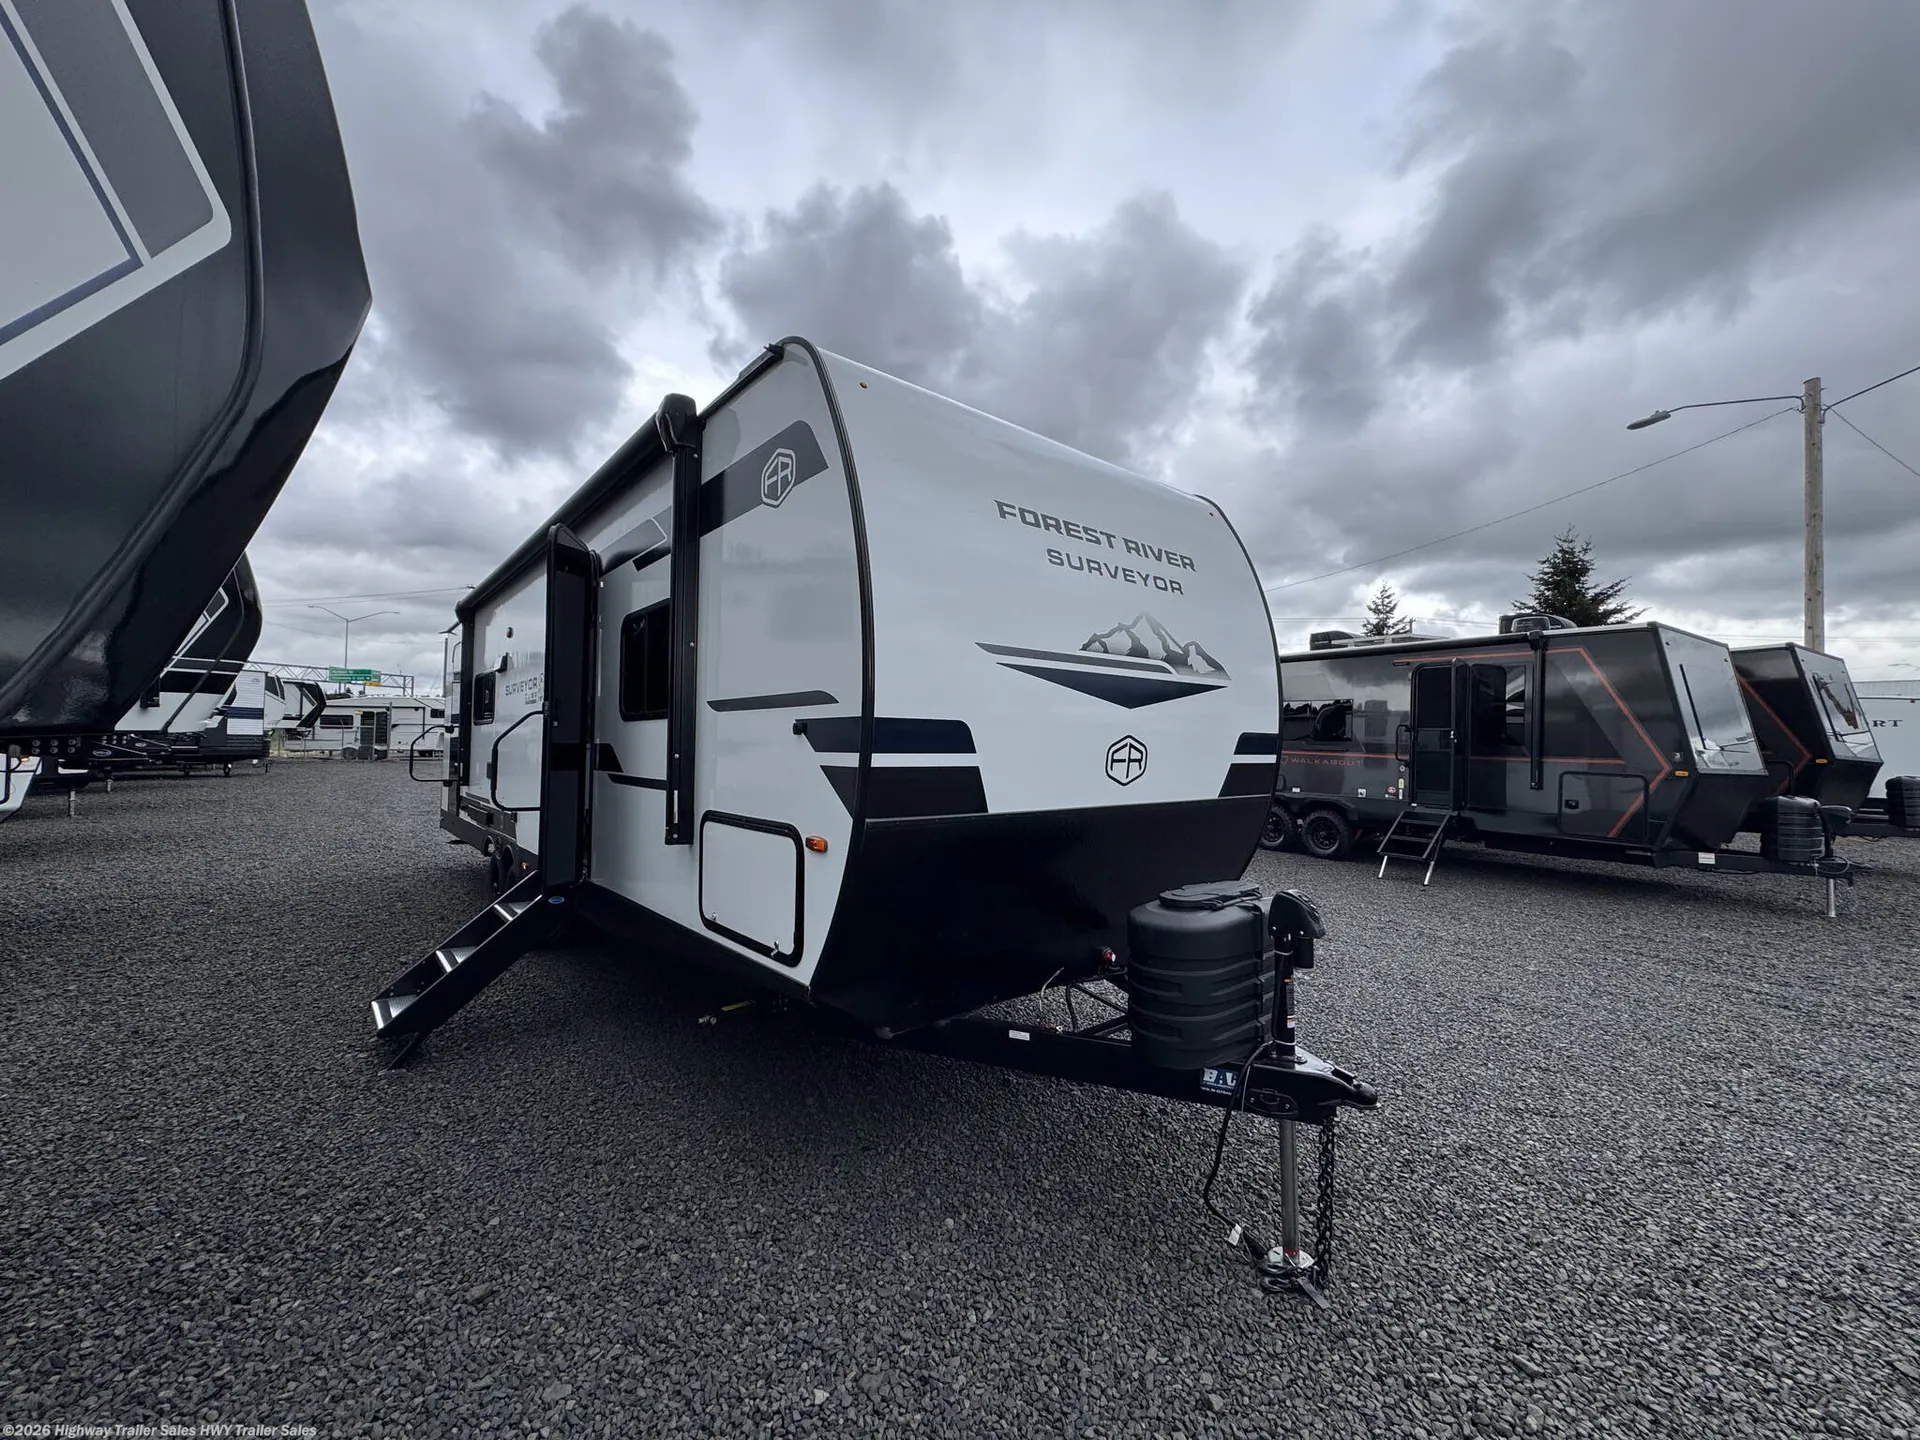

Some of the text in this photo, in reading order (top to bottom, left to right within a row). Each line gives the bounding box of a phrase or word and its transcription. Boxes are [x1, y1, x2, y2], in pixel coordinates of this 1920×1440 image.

[994, 499, 1196, 573] FOREST RIVER
[1046, 548, 1184, 596] SURVEYOR
[1290, 757, 1362, 767] WALKABOUT
